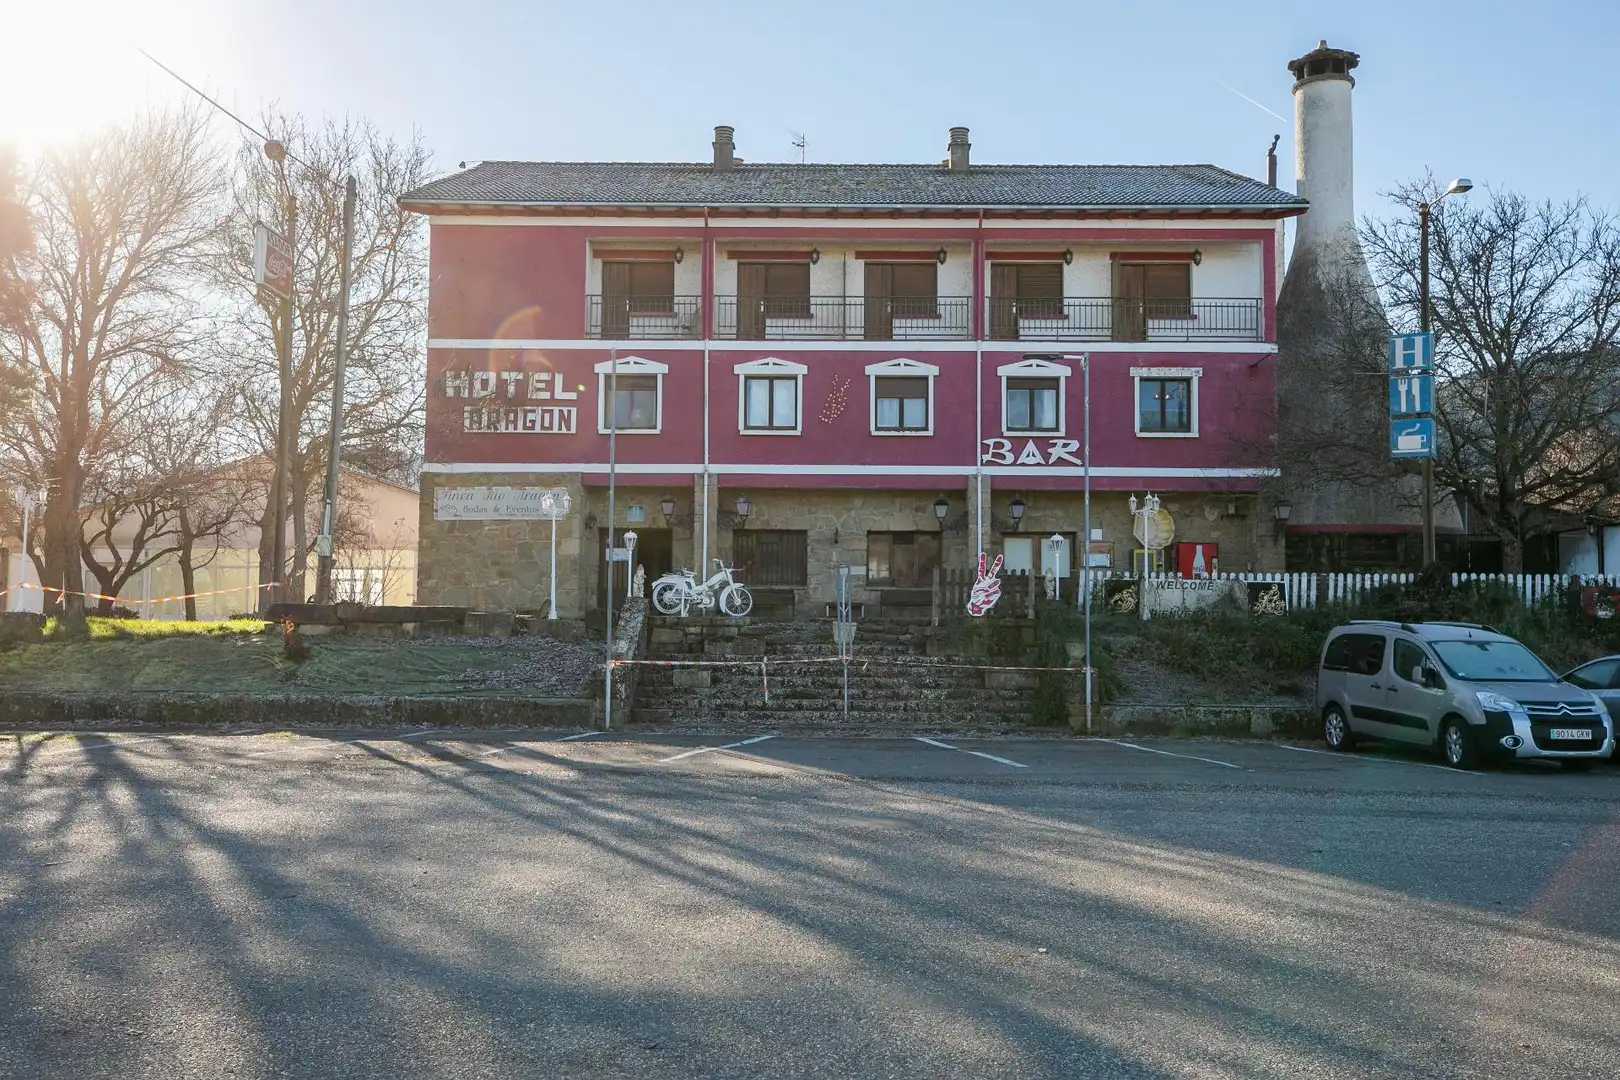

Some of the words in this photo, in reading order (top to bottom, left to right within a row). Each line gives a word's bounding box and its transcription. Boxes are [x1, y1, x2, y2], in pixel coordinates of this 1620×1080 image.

[1391, 335, 1427, 369] H
[445, 371, 577, 399] HOTEL
[981, 438, 1083, 466] BAR
[463, 504, 488, 513] Bodas
[506, 505, 540, 513] Eventos
[1155, 580, 1215, 591] WELCOME
[1555, 730, 1575, 738] 9014
